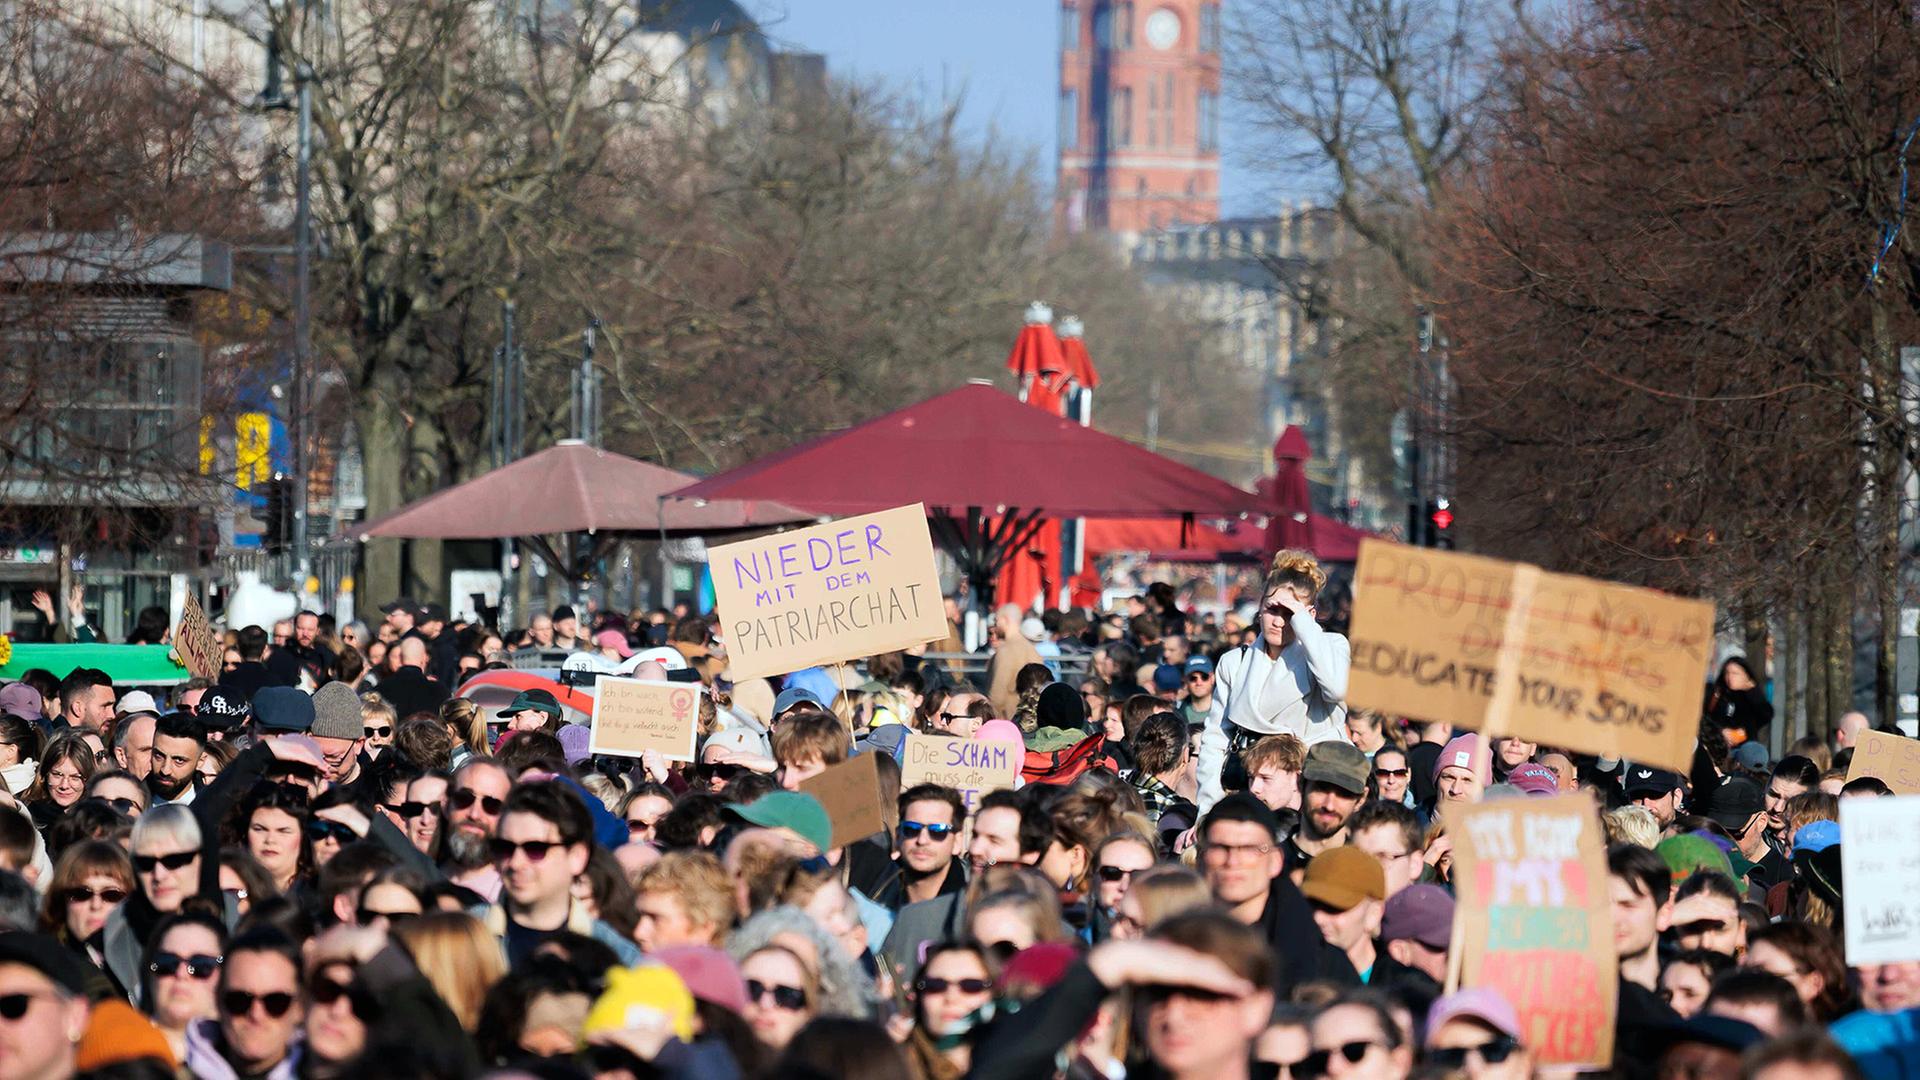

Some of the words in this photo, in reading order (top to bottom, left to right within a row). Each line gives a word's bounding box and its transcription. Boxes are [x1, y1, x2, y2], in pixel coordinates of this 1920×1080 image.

[733, 524, 891, 589] NIEDER
[755, 583, 796, 607] MIT
[826, 570, 871, 591] DEM
[734, 583, 921, 655] PATRIARCHAT
[1350, 639, 1498, 697] EDUCATE
[1517, 674, 1583, 720] YOUR
[1586, 690, 1670, 735] SONS
[912, 742, 939, 764] Die
[946, 742, 1007, 769] SCHAM
[924, 771, 961, 785] muss
[965, 770, 984, 785] die
[1494, 858, 1566, 906] MY
